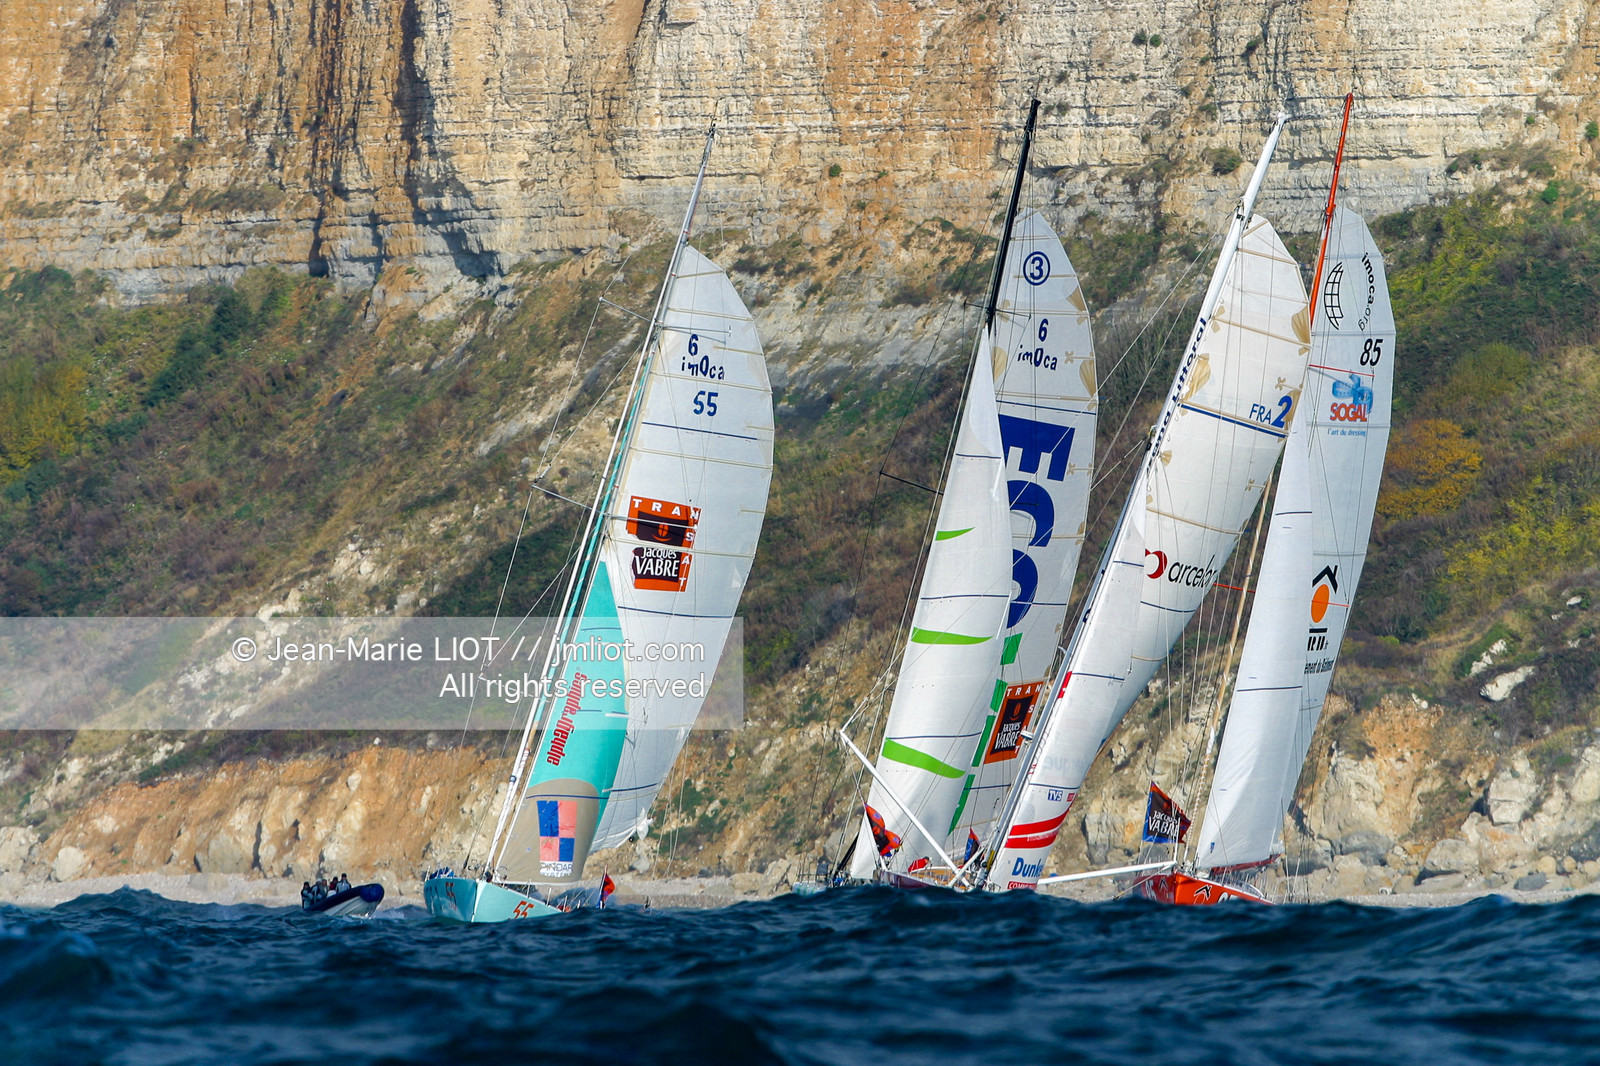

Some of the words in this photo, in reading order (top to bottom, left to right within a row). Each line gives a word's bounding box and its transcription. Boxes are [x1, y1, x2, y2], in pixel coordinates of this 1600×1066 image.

[1029, 256, 1044, 281] 3
[1038, 318, 1049, 342] 6
[688, 333, 699, 356] 6
[1360, 338, 1383, 367] 85
[692, 390, 719, 417] 55
[1249, 402, 1273, 425] FRA
[1270, 395, 1293, 428] 2
[1329, 402, 1368, 423] SOGAL
[634, 556, 680, 578] VABRE
[1048, 790, 1063, 801] TV5
